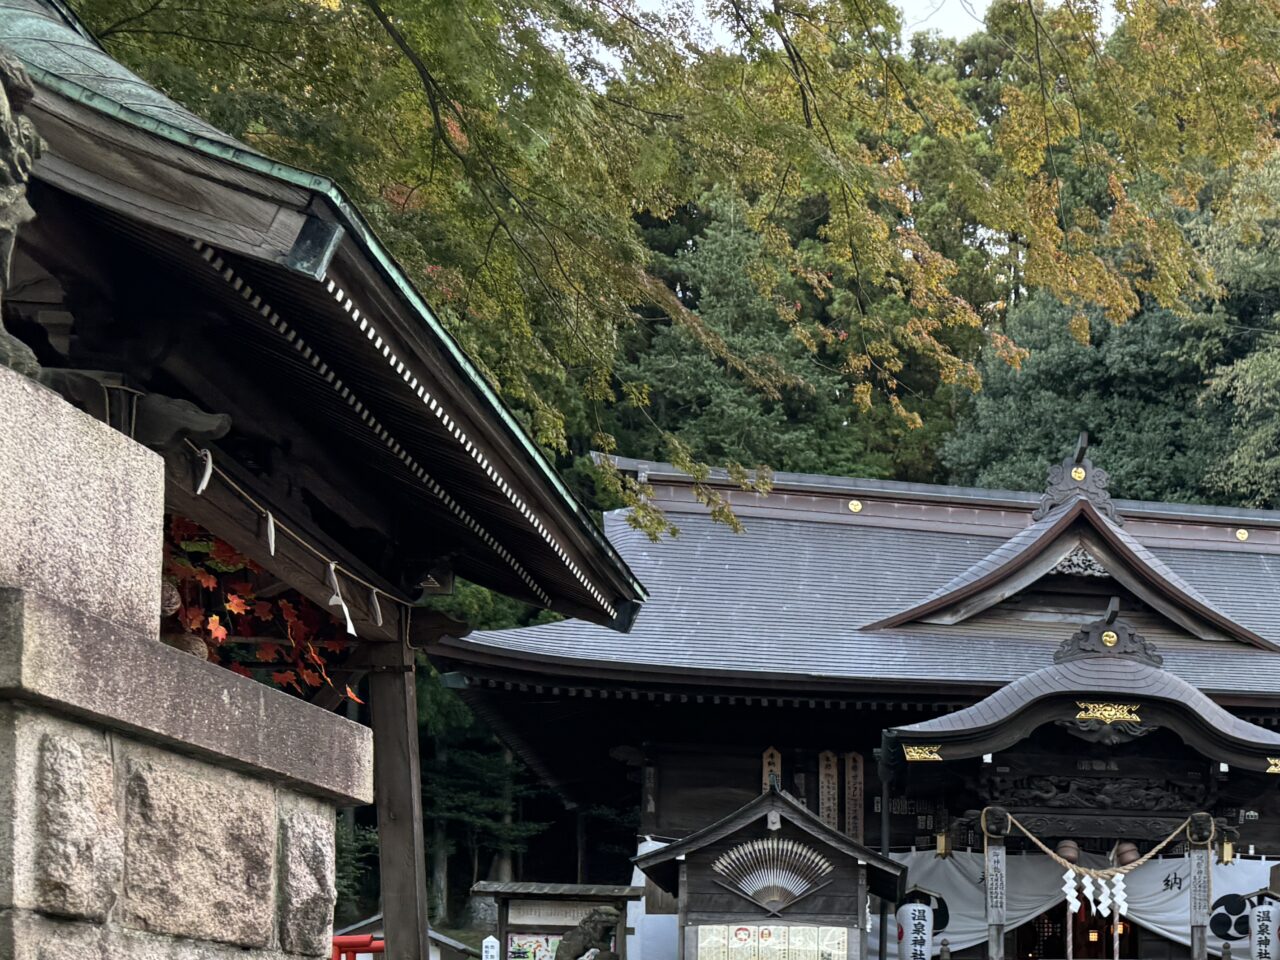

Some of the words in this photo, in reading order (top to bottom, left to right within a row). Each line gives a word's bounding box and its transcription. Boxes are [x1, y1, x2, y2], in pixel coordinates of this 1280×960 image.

[1162, 871, 1183, 892] 納
[910, 908, 928, 960] 温泉神社
[1255, 910, 1272, 960] 温泉神社
